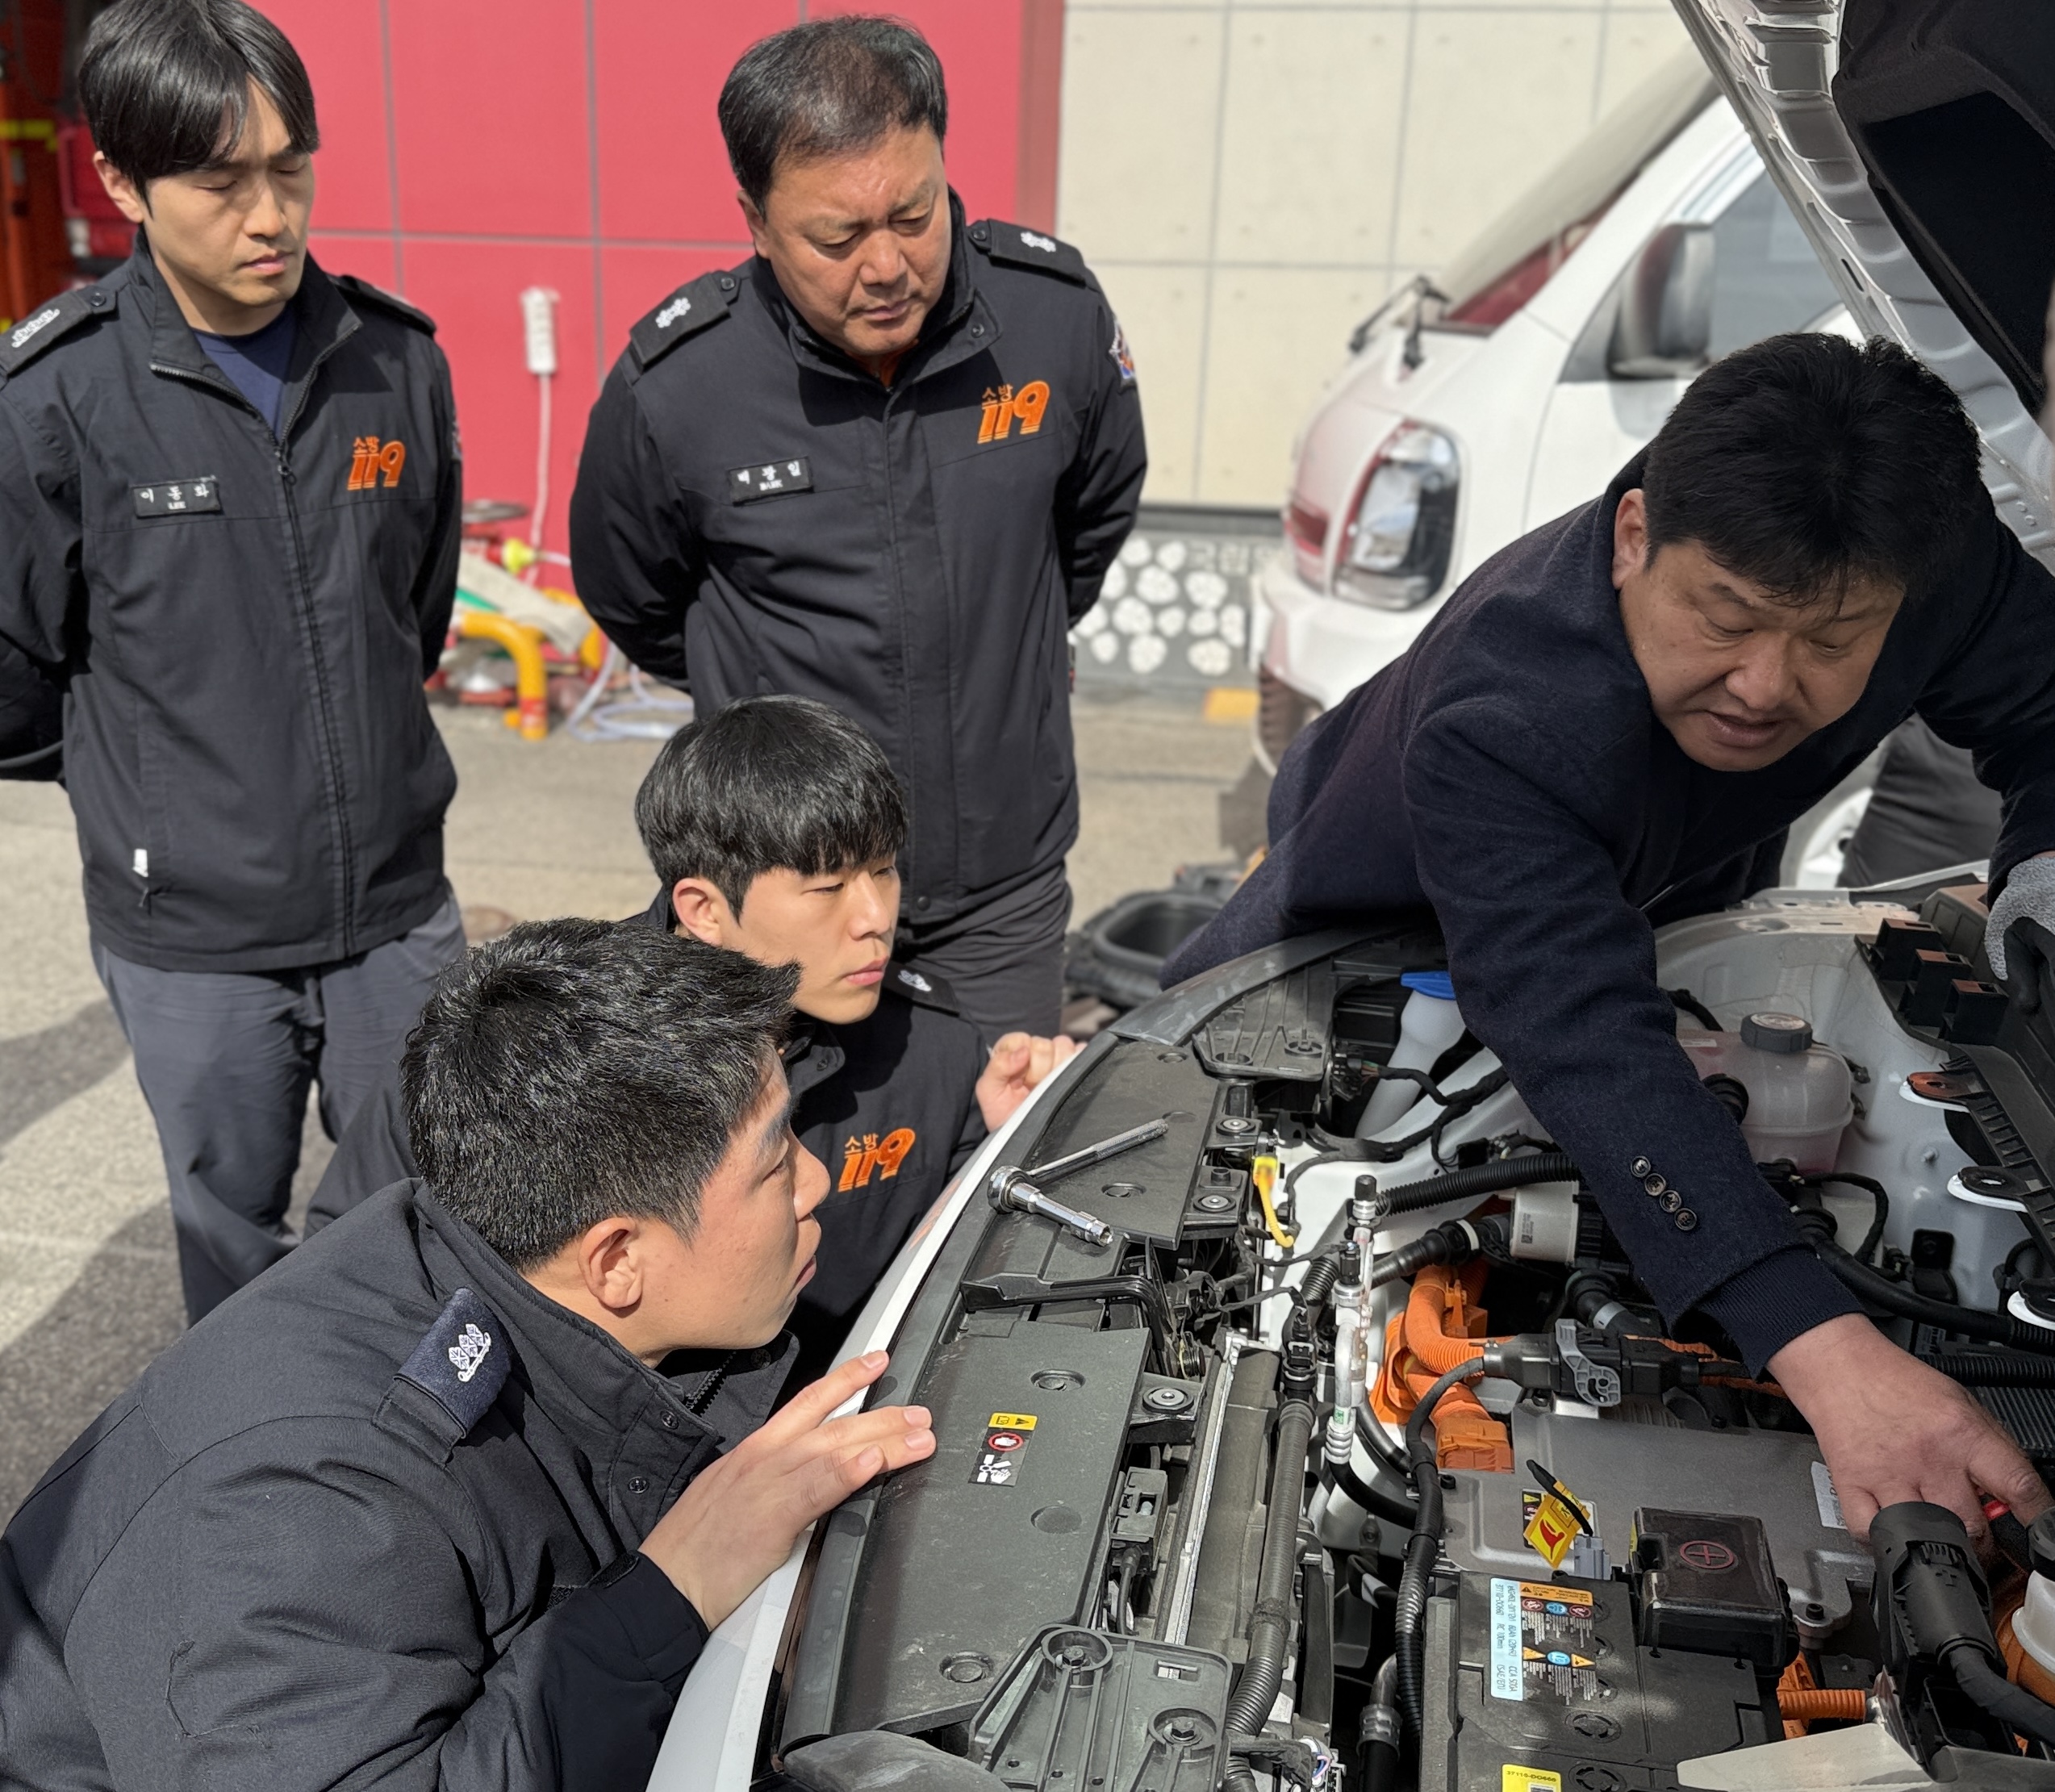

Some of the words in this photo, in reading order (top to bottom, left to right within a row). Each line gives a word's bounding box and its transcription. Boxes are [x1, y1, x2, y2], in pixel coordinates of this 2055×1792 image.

[982, 383, 1013, 405] 소방
[977, 380, 1050, 445] 119
[353, 436, 380, 453] 소방
[347, 441, 406, 491] 119
[167, 500, 186, 511] LEE
[845, 1132, 879, 1155] 소방
[837, 1127, 916, 1193] 119
